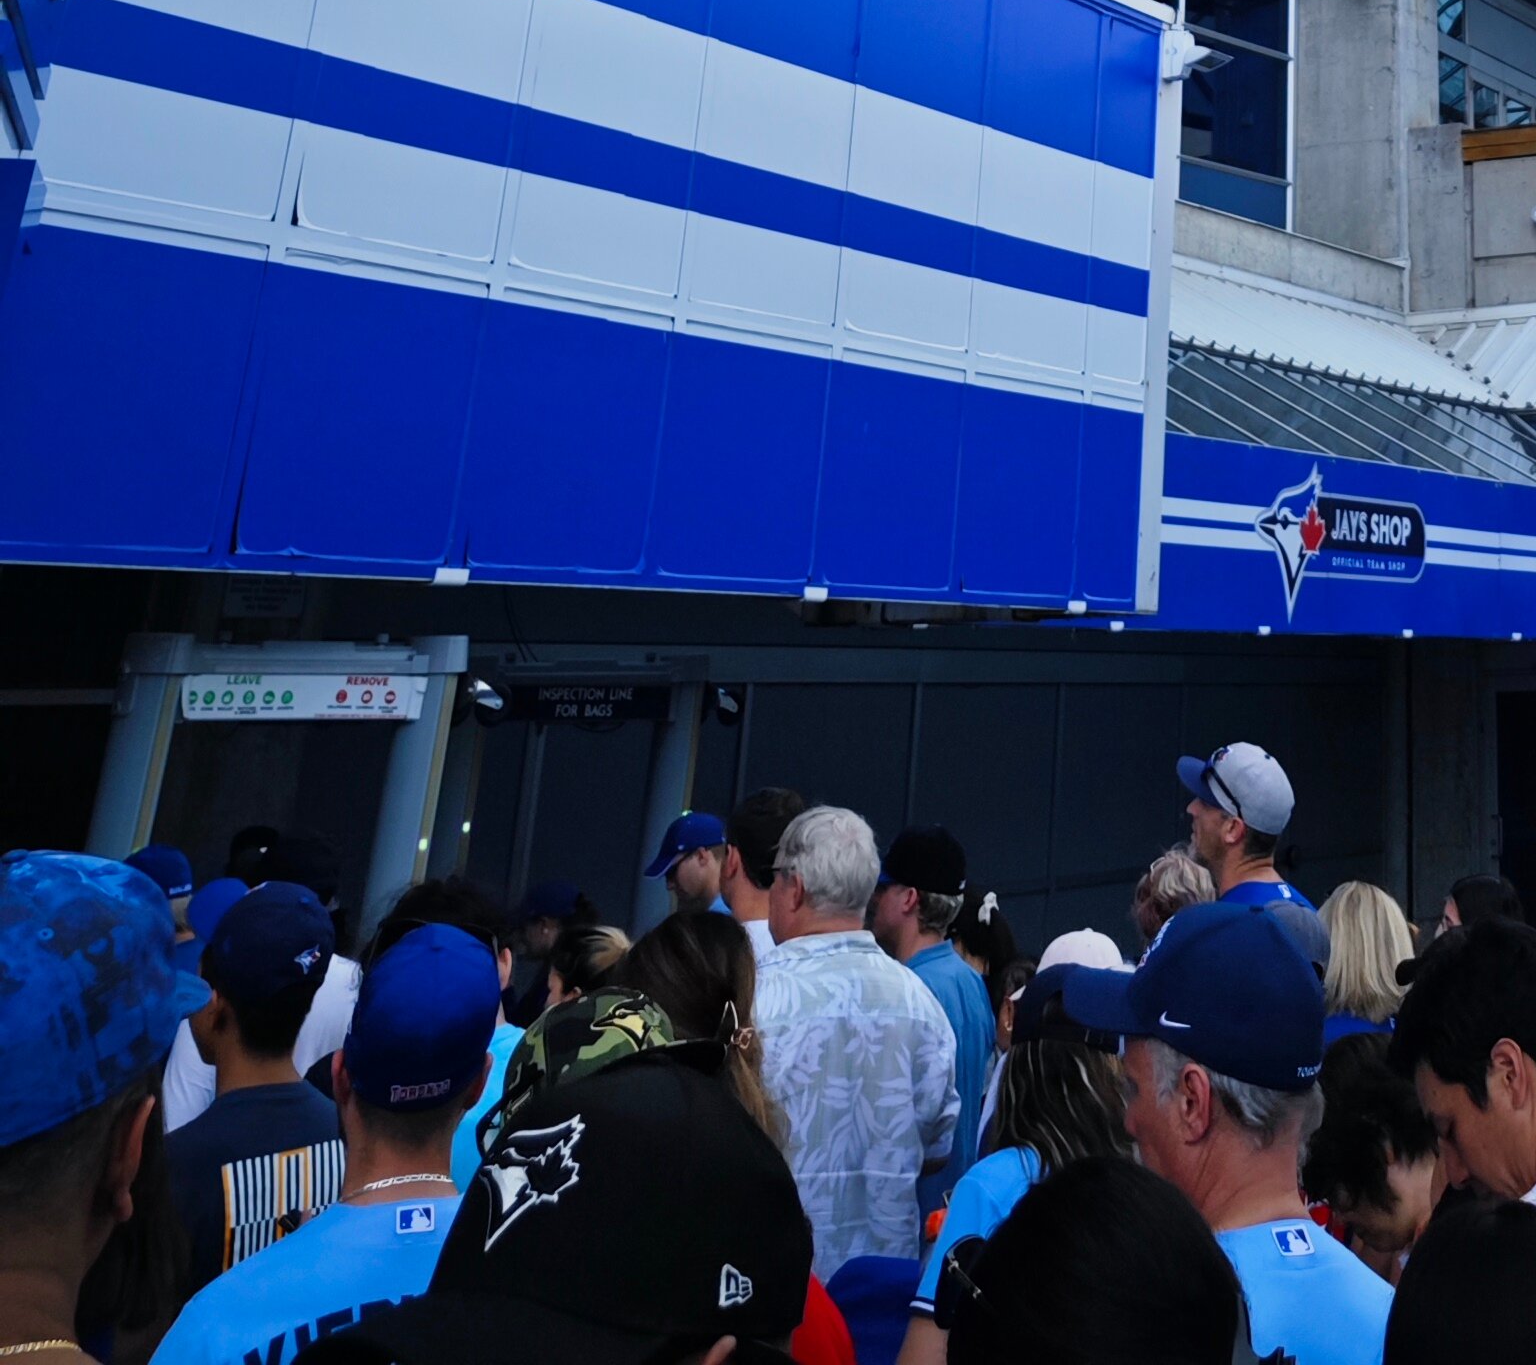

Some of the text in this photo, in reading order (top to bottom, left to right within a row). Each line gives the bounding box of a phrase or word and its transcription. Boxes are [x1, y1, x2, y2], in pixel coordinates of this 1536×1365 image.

[1331, 509, 1412, 546] JAYS SHOP
[227, 674, 390, 687] LEAVE REMOVE
[538, 686, 634, 701] INSPECTION LINE
[555, 703, 614, 718] FOR BAGS
[390, 1078, 451, 1103] TORONTO
